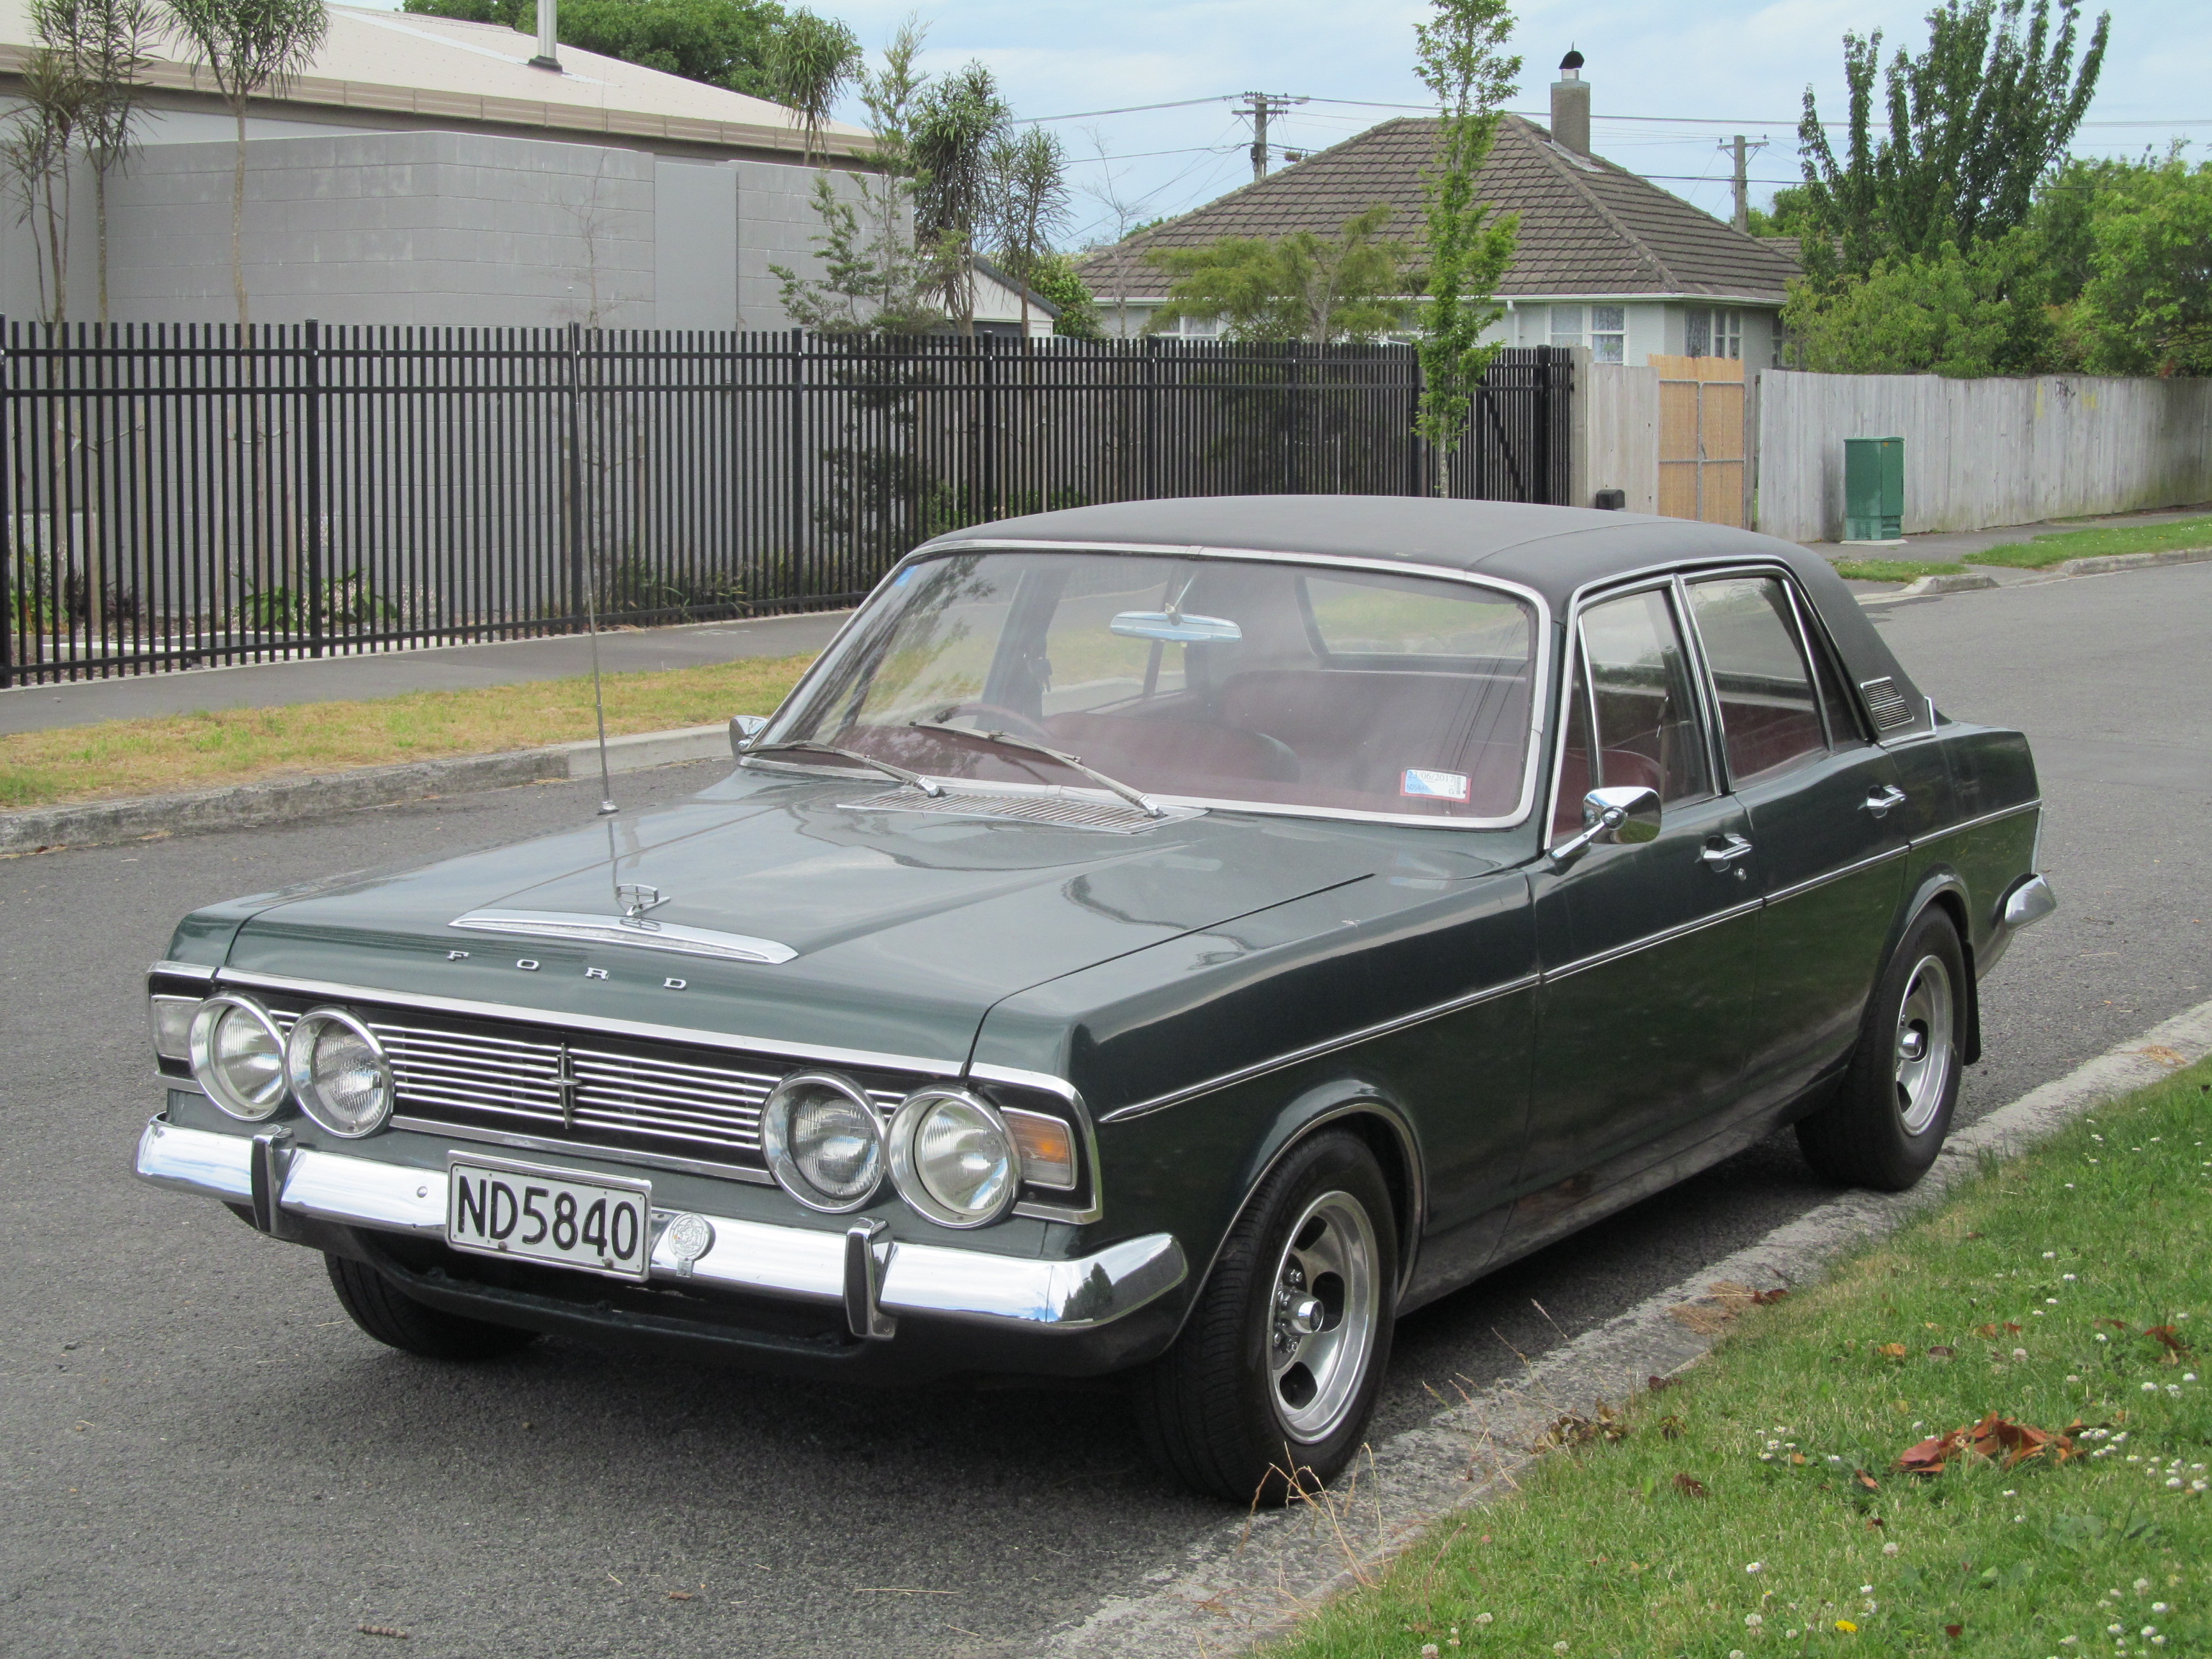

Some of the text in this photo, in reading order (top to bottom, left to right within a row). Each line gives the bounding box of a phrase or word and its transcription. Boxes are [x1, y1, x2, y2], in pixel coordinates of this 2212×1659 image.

[1408, 770, 1455, 782] 23/06/2017
[446, 950, 688, 992] FORD
[457, 1174, 639, 1261] ND5840
